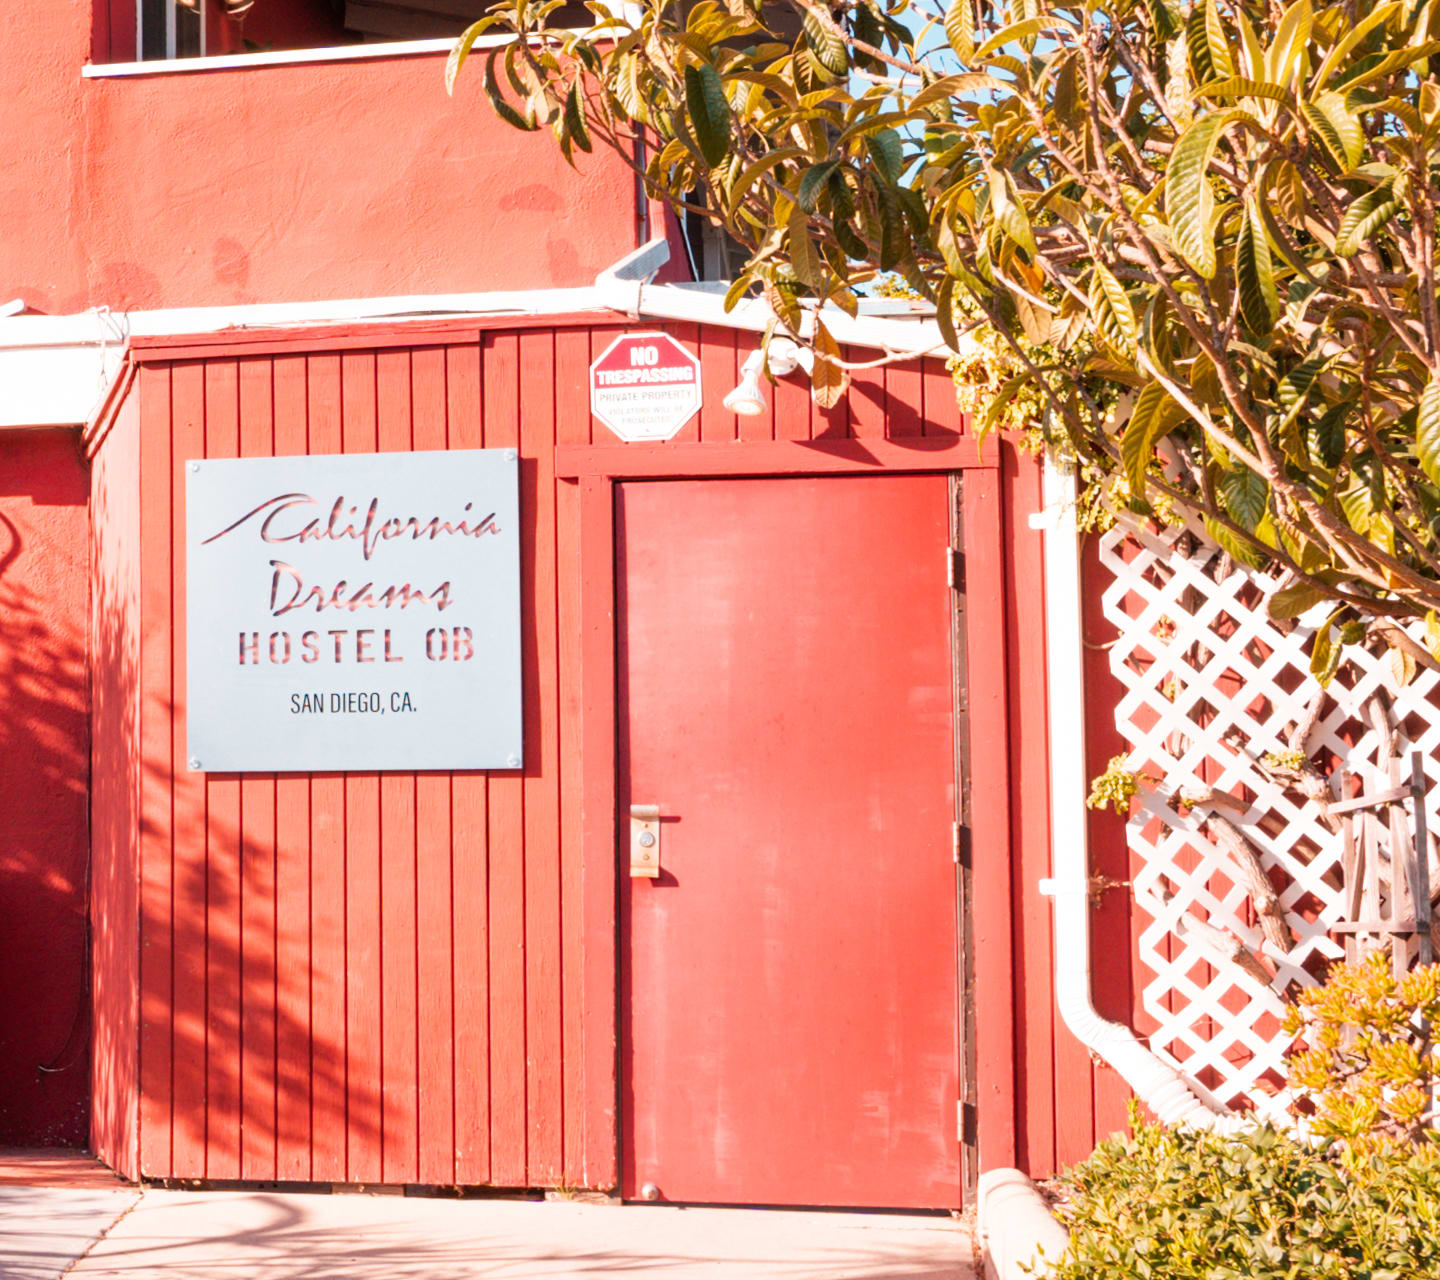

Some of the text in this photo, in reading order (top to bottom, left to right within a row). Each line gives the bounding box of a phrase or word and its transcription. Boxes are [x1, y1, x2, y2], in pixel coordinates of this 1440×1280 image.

[630, 346, 659, 366] NO
[596, 366, 693, 385] TRESPASSING
[599, 389, 691, 402] PRIVATE PROPERTY
[201, 493, 502, 560] California
[269, 559, 454, 616] Dreams
[238, 626, 475, 666] HOSTEL OB
[290, 692, 417, 715] SAN DIEGO, CA.
